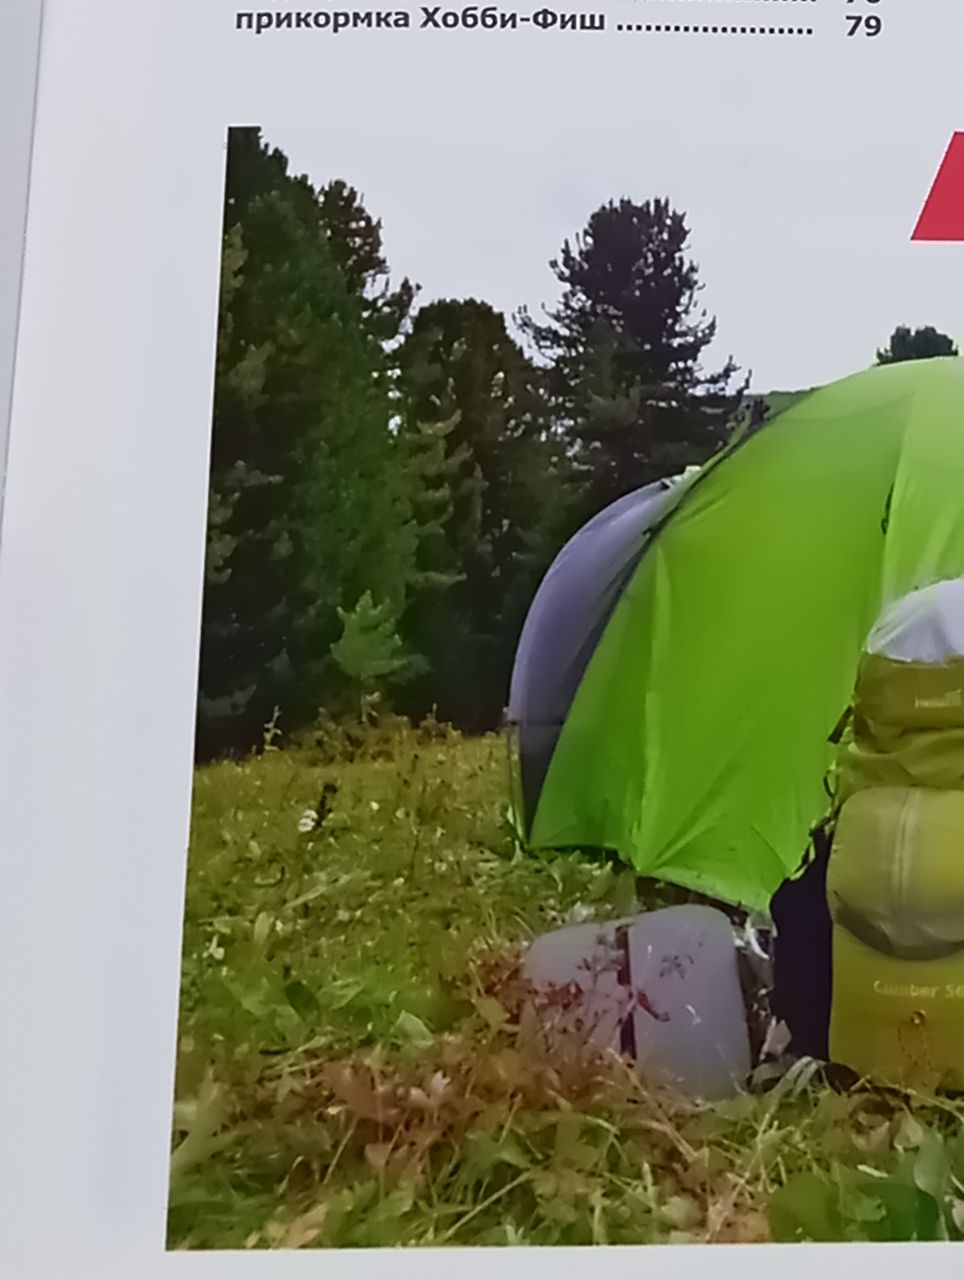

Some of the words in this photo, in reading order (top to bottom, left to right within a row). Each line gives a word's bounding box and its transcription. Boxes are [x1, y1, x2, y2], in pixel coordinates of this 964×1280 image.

[235, 10, 410, 35] прикормка
[419, 5, 606, 31] Хобби-Фиш
[845, 14, 882, 38] 79
